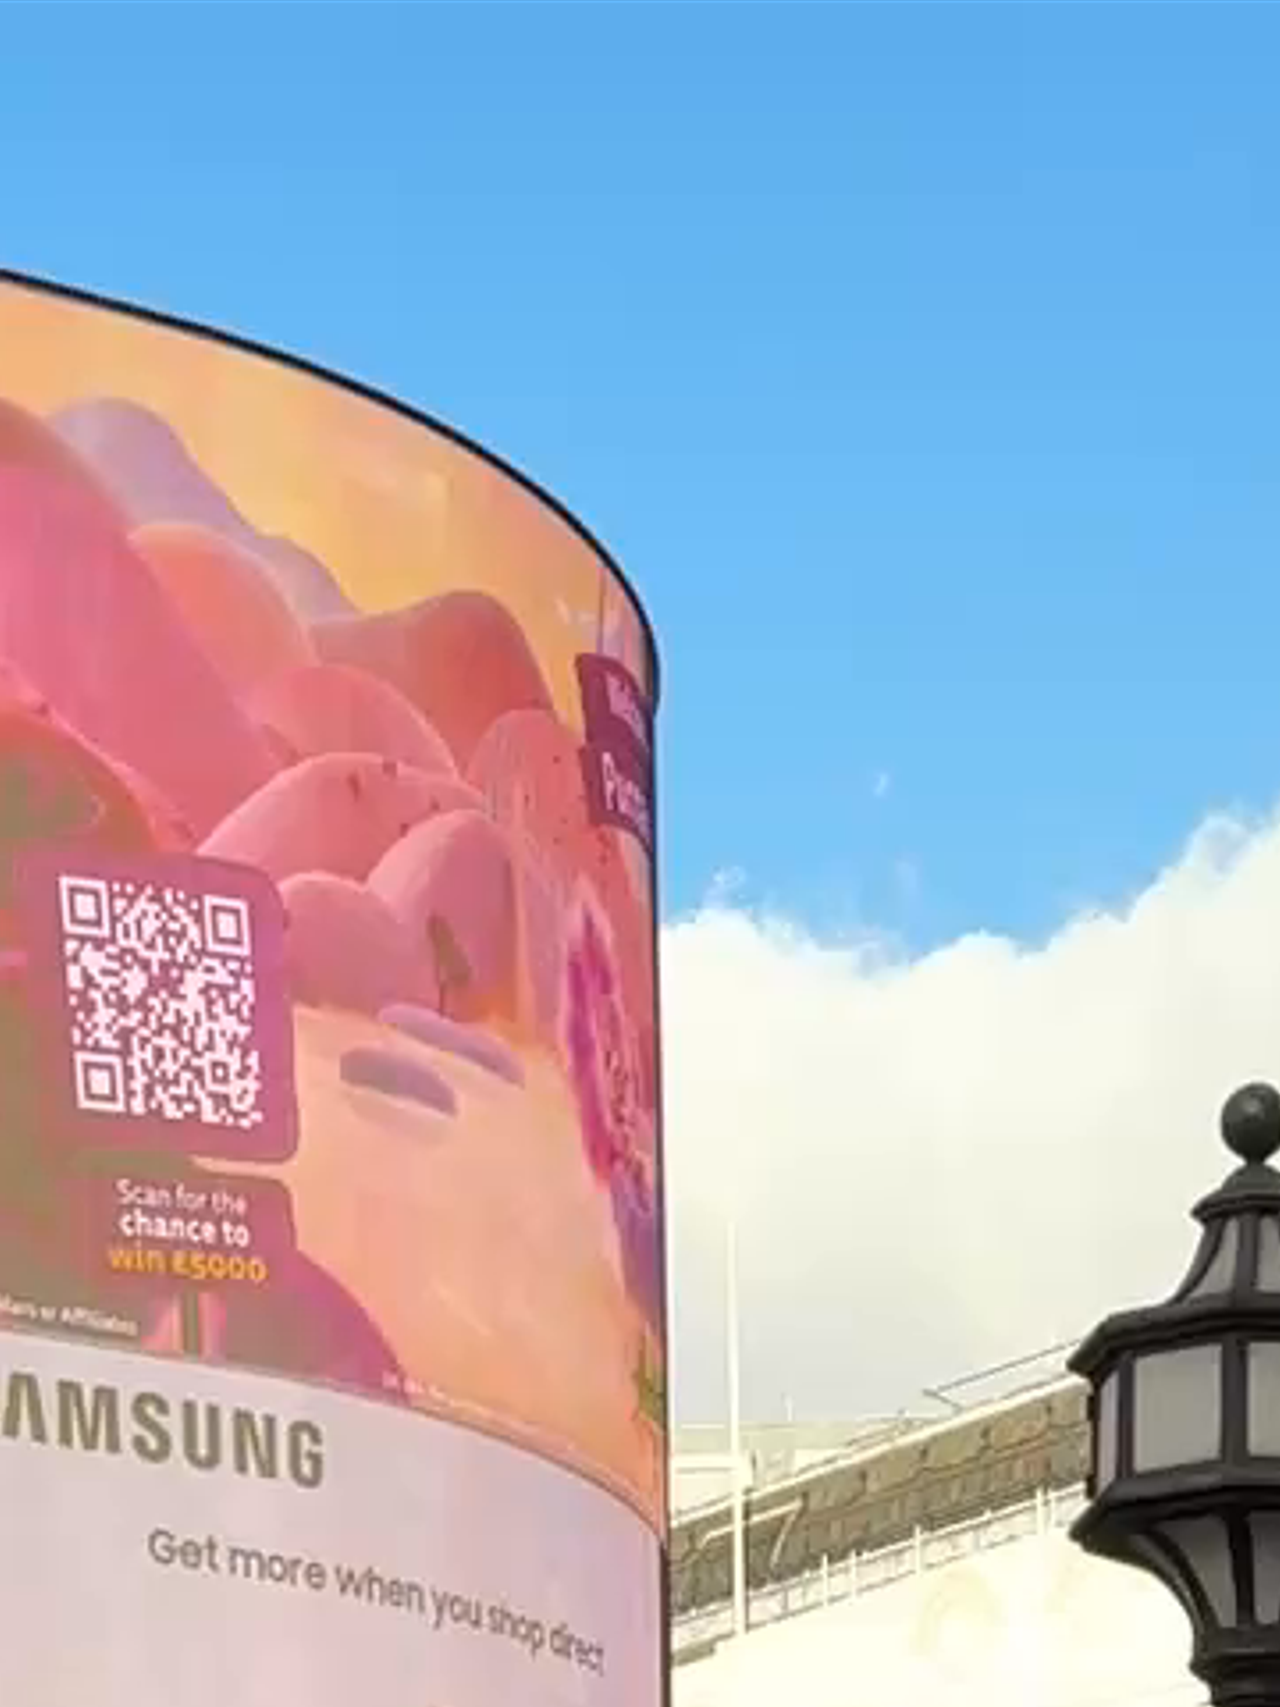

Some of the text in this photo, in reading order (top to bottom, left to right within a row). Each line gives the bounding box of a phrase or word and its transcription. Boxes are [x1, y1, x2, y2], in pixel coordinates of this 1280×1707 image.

[117, 1179, 247, 1216] Scan for the
[120, 1209, 250, 1247] chance to
[110, 1246, 165, 1272] win
[148, 1528, 604, 1677] Get more when you shop direct
